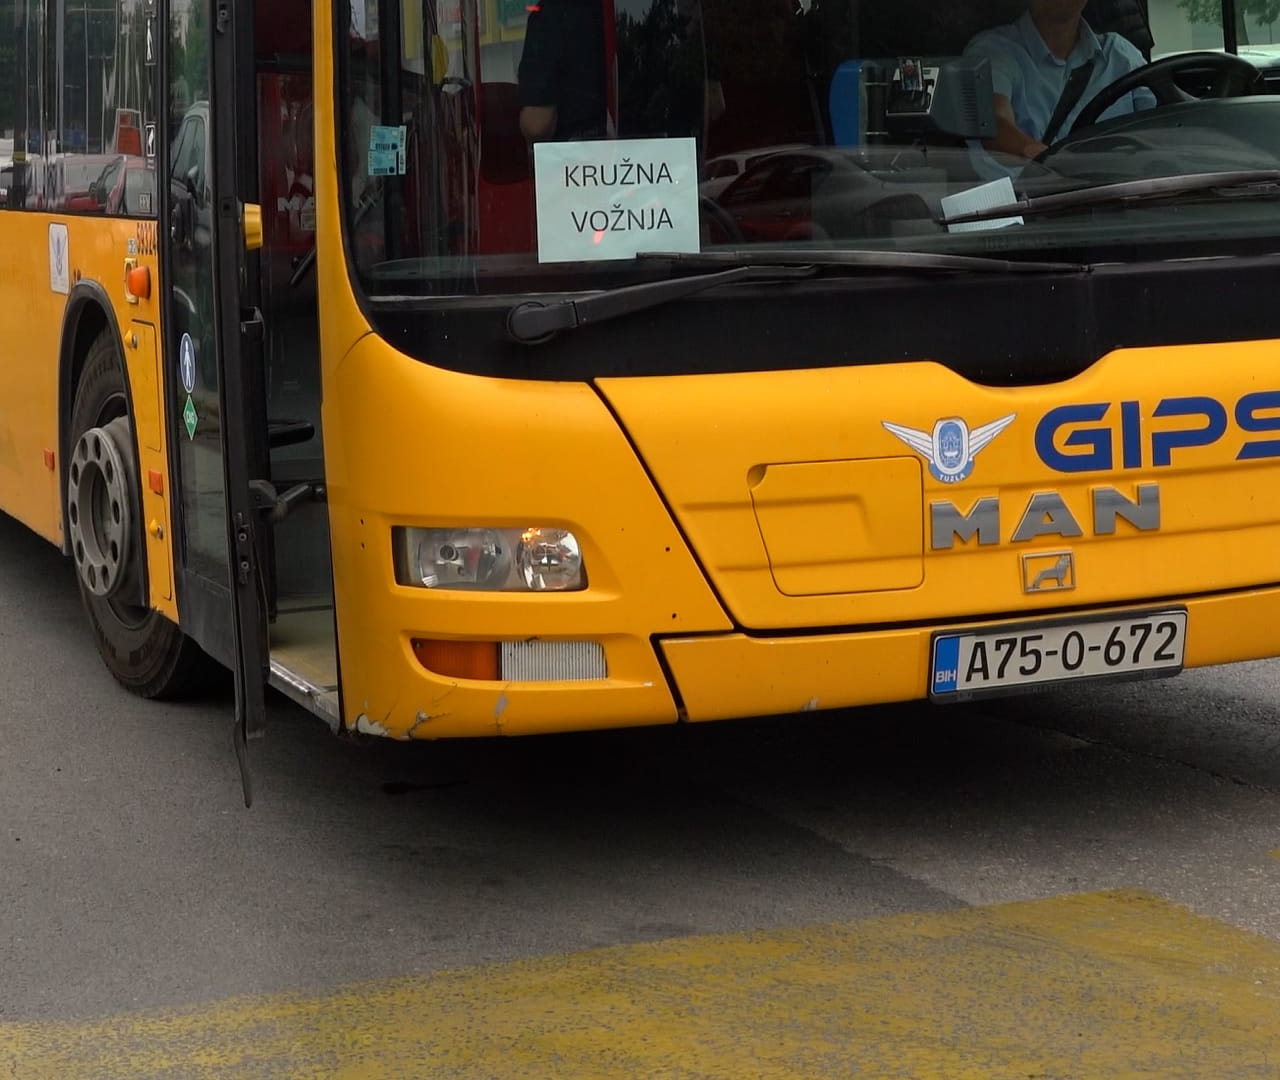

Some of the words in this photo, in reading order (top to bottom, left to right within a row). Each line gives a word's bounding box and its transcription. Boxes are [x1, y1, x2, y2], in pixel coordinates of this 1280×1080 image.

[564, 157, 673, 188] KRUŽNA
[570, 203, 674, 233] VOŽNJA
[939, 471, 966, 483] TUZLA
[929, 482, 1162, 551] MAN
[935, 668, 957, 684] BIH
